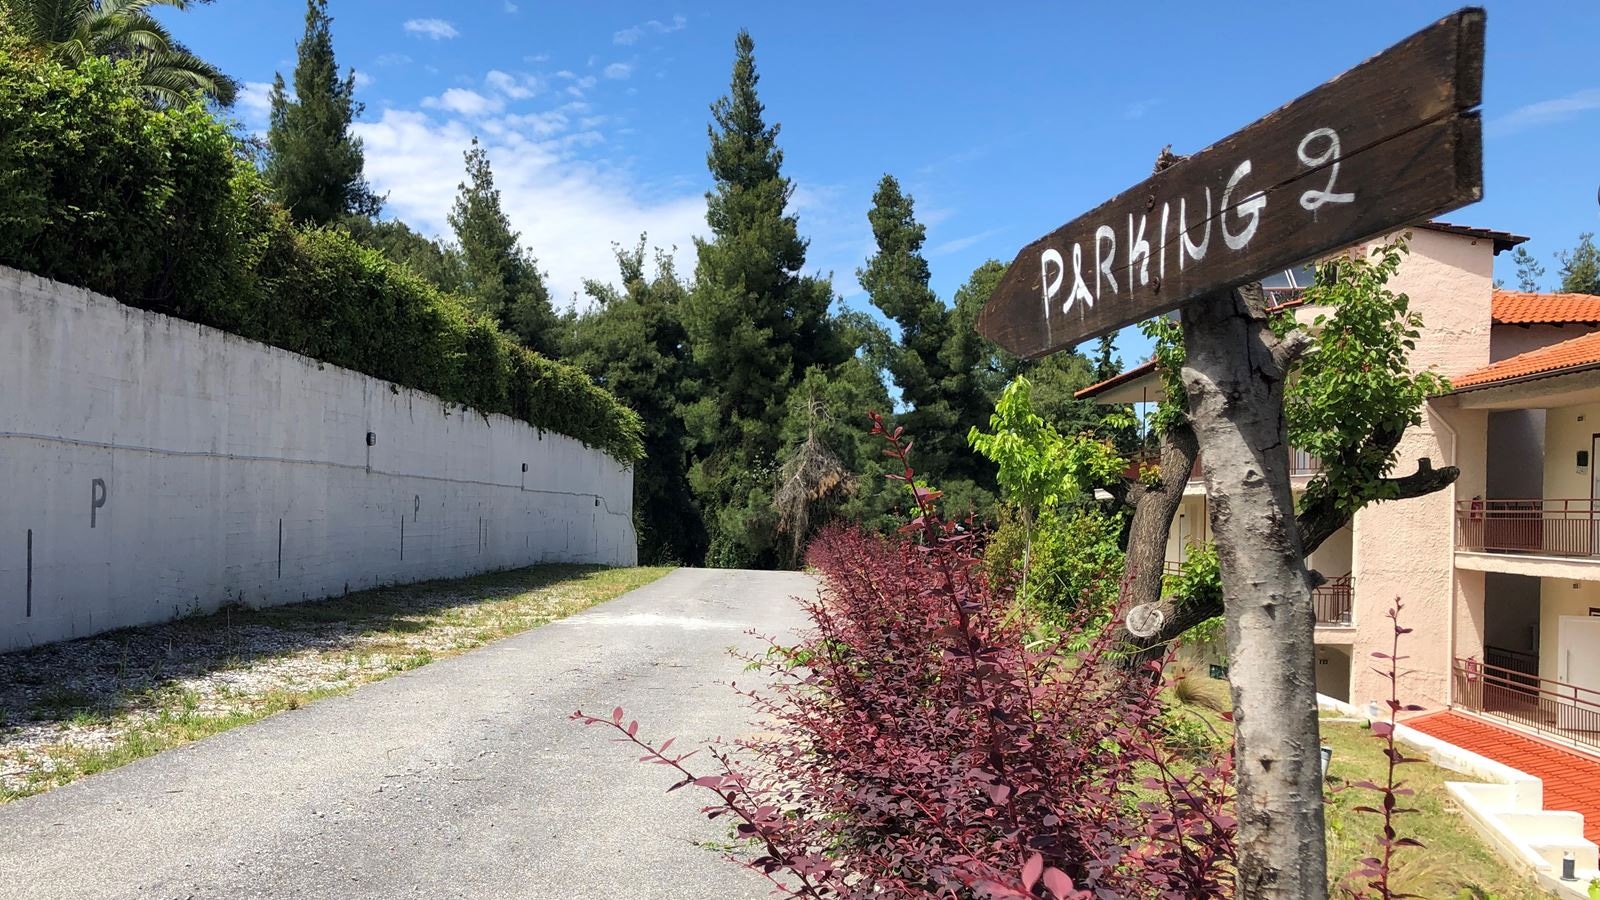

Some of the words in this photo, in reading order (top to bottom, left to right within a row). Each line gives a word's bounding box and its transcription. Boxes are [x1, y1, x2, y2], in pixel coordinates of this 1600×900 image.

[1041, 159, 1267, 320] PARKING
[1296, 127, 1355, 211] 2
[90, 478, 107, 529] P
